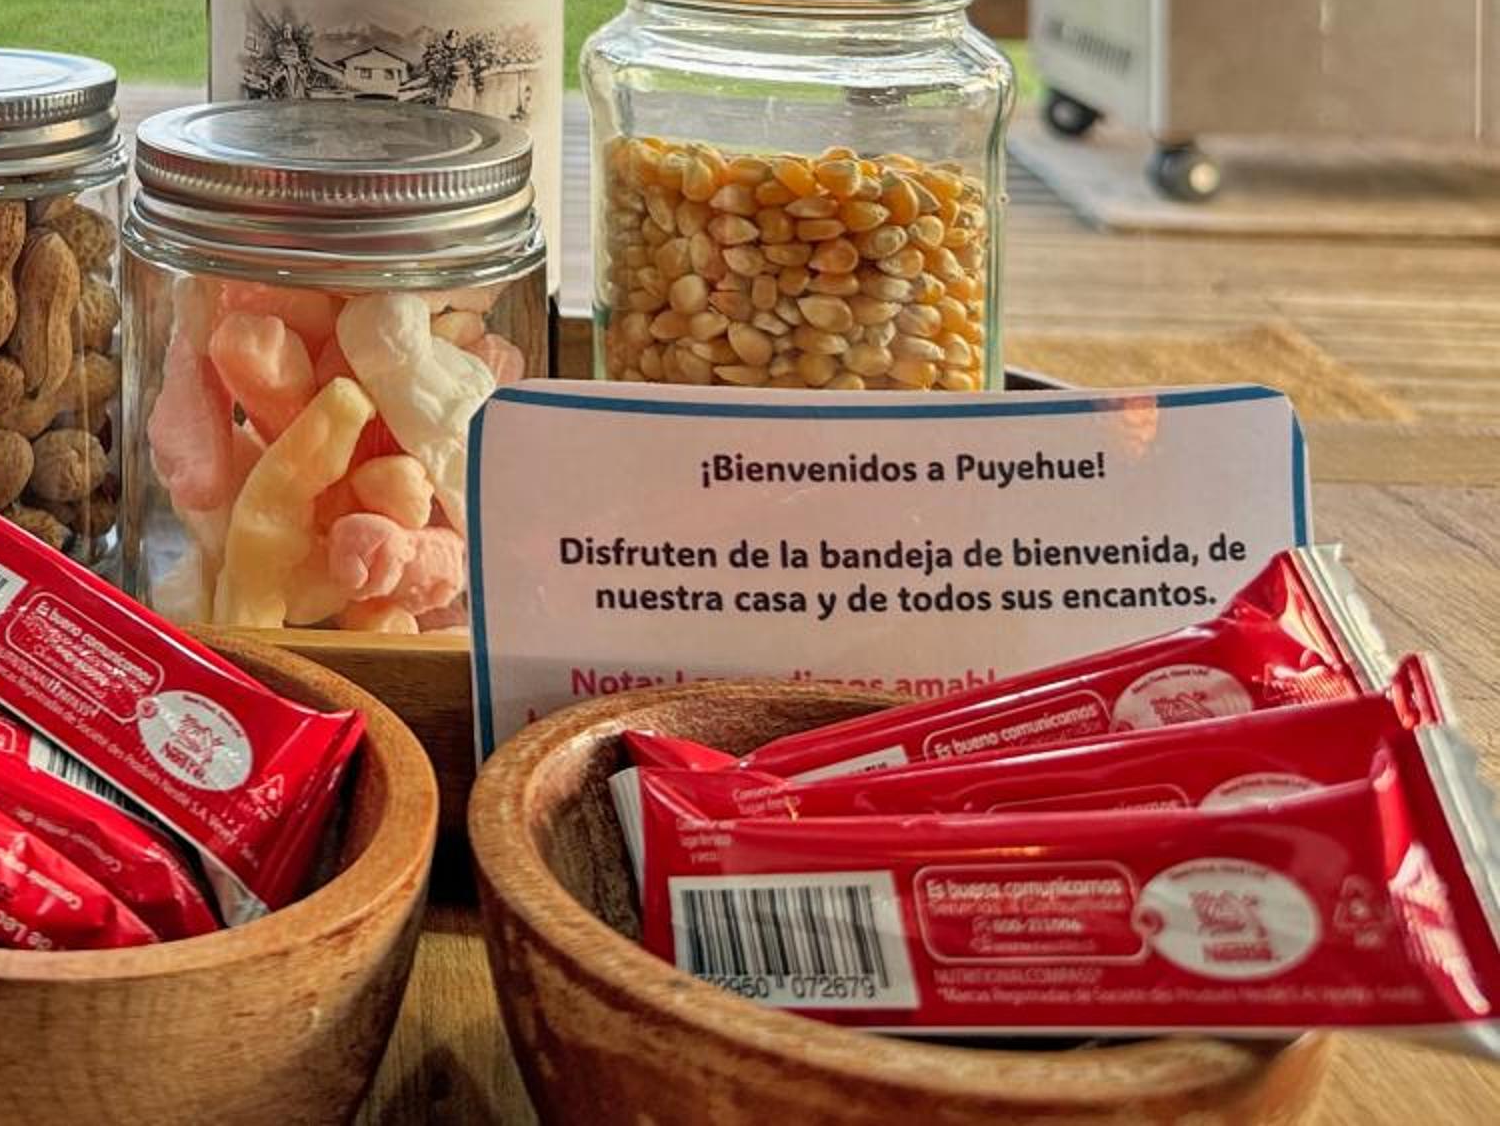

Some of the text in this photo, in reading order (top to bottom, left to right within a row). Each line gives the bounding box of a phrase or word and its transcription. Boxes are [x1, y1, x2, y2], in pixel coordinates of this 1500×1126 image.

[700, 451, 1106, 490] ¡Bienvenidos a Puyehue!
[559, 532, 1247, 576] Disfruten de la bandeja de bienvenida, de
[596, 582, 1217, 621] nuestra casa y de todos sus encantos.
